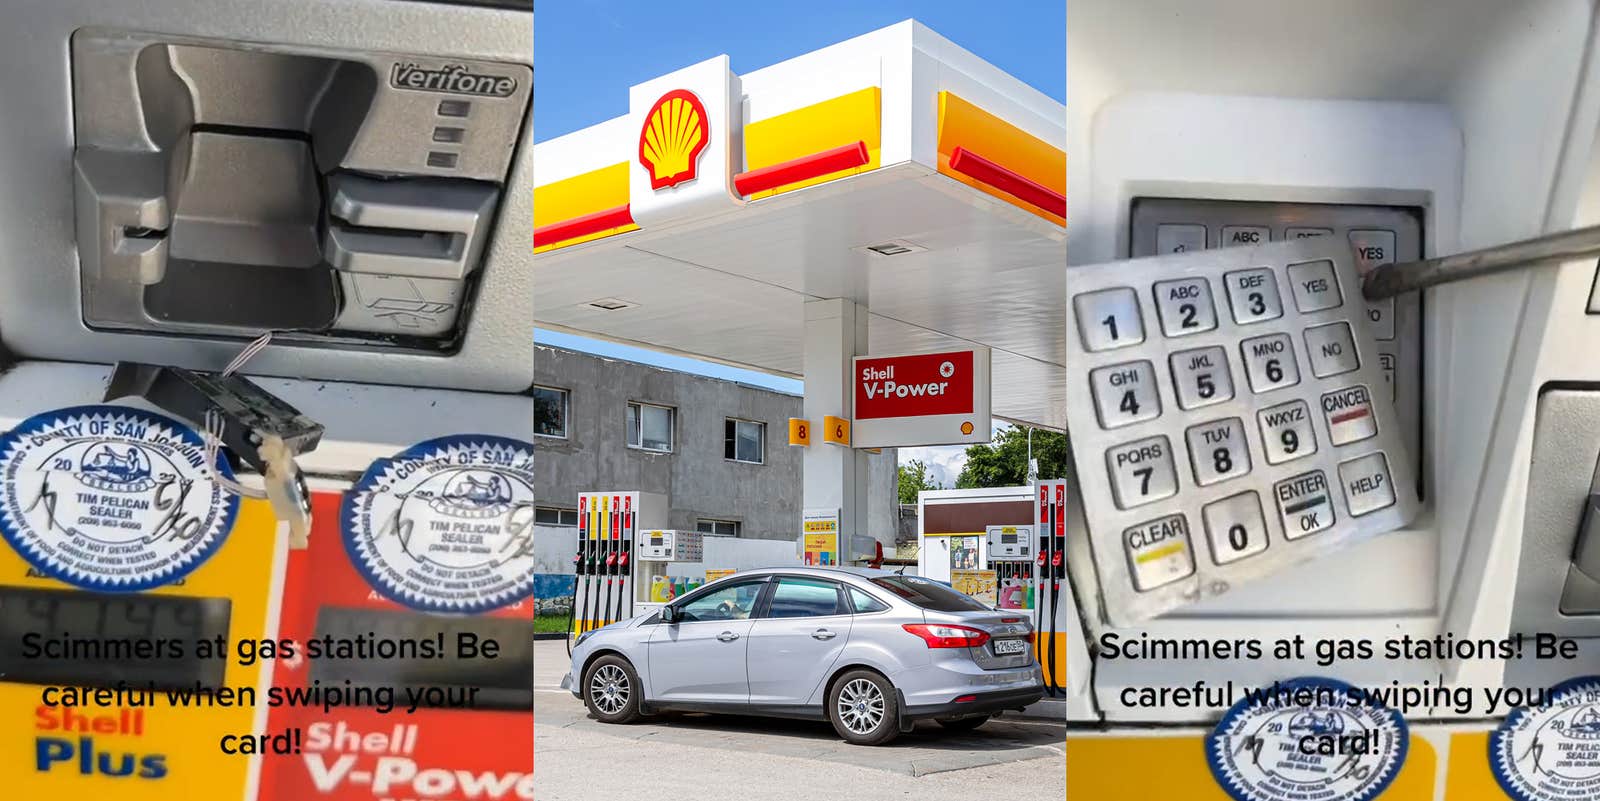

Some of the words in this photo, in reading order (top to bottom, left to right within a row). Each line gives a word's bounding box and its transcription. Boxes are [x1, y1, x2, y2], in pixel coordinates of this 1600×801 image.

[392, 63, 516, 94] Verifone
[1232, 232, 1259, 243] ABC
[1359, 247, 1384, 260] YES
[1239, 274, 1265, 290] DEF
[1302, 278, 1328, 293] YES
[1169, 284, 1199, 299] ABC
[1247, 291, 1266, 316] 3
[1179, 304, 1199, 329] 2
[1101, 314, 1119, 341] 1
[1253, 340, 1284, 356] MNO
[1322, 343, 1342, 357] NO
[1188, 355, 1214, 371] JKL
[1265, 359, 1284, 384] 6
[862, 365, 894, 381] Shell
[1109, 369, 1139, 387] GHI
[862, 381, 948, 400] V-Power
[1197, 373, 1216, 400] 5
[1119, 389, 1140, 416] 4
[1323, 388, 1370, 413] CANCEL
[1265, 409, 1305, 428] WXYZ
[89, 421, 110, 436] OF
[114, 421, 146, 439] SAN
[798, 425, 806, 439] 8
[836, 424, 843, 439] 6
[1201, 426, 1231, 445] TUV
[1281, 429, 1299, 454] 9
[54, 458, 73, 471] 20
[458, 450, 477, 464] OF
[482, 449, 514, 467] SAN
[1117, 446, 1163, 468] PQRS
[1213, 447, 1232, 473] 8
[1133, 468, 1154, 496] 7
[1279, 474, 1325, 501] ENTER
[1351, 473, 1384, 497] HELP
[76, 493, 98, 504] TIM
[101, 495, 149, 510] PELICAN
[89, 506, 132, 519] SEALER
[1300, 511, 1319, 531] OK
[430, 521, 450, 532] TIM
[453, 522, 500, 535] PELICAN
[1128, 519, 1183, 550] CLEAR
[72, 536, 86, 547] DO
[87, 543, 106, 553] NOT
[108, 544, 144, 555] DETACH
[441, 532, 483, 545] SEALER
[1229, 524, 1248, 551] 0
[35, 538, 56, 556] FOOD
[58, 541, 95, 561] CORRECT
[98, 556, 122, 565] WHEN
[126, 551, 157, 564] TESTED
[35, 703, 145, 737] Shell
[1267, 722, 1283, 733] 20
[1551, 720, 1565, 730] 20
[305, 720, 419, 754] Shell
[1279, 743, 1295, 752] TIM
[1558, 743, 1574, 751] TIM
[1566, 752, 1598, 760] SEALER
[35, 735, 169, 780] Plus
